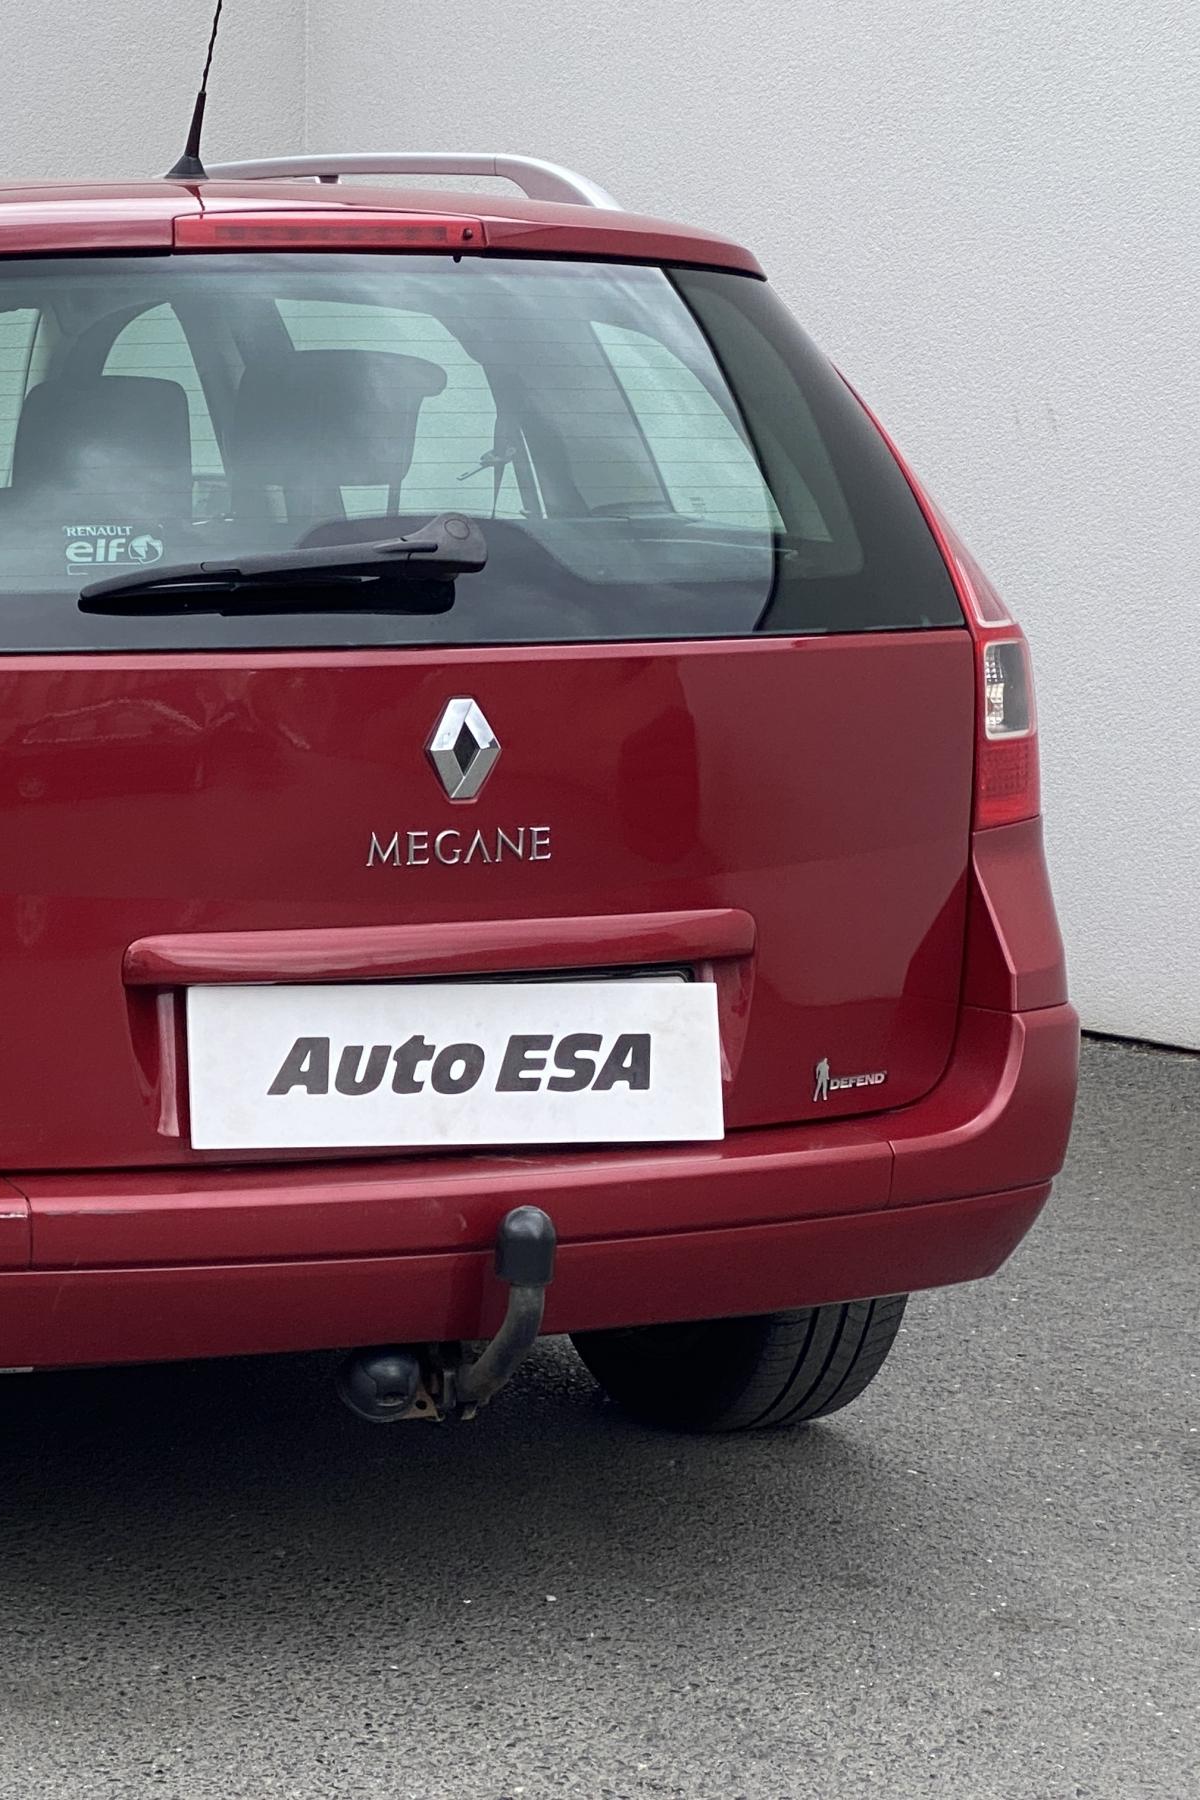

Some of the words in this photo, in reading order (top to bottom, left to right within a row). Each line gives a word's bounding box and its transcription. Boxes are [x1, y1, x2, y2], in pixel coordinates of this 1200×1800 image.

[65, 525, 133, 537] RENAULT
[65, 538, 126, 562] elf
[365, 826, 552, 867] MEGANE
[266, 1034, 486, 1096] Auto
[495, 1032, 651, 1093] ESA
[829, 1072, 886, 1090] DEFEND
